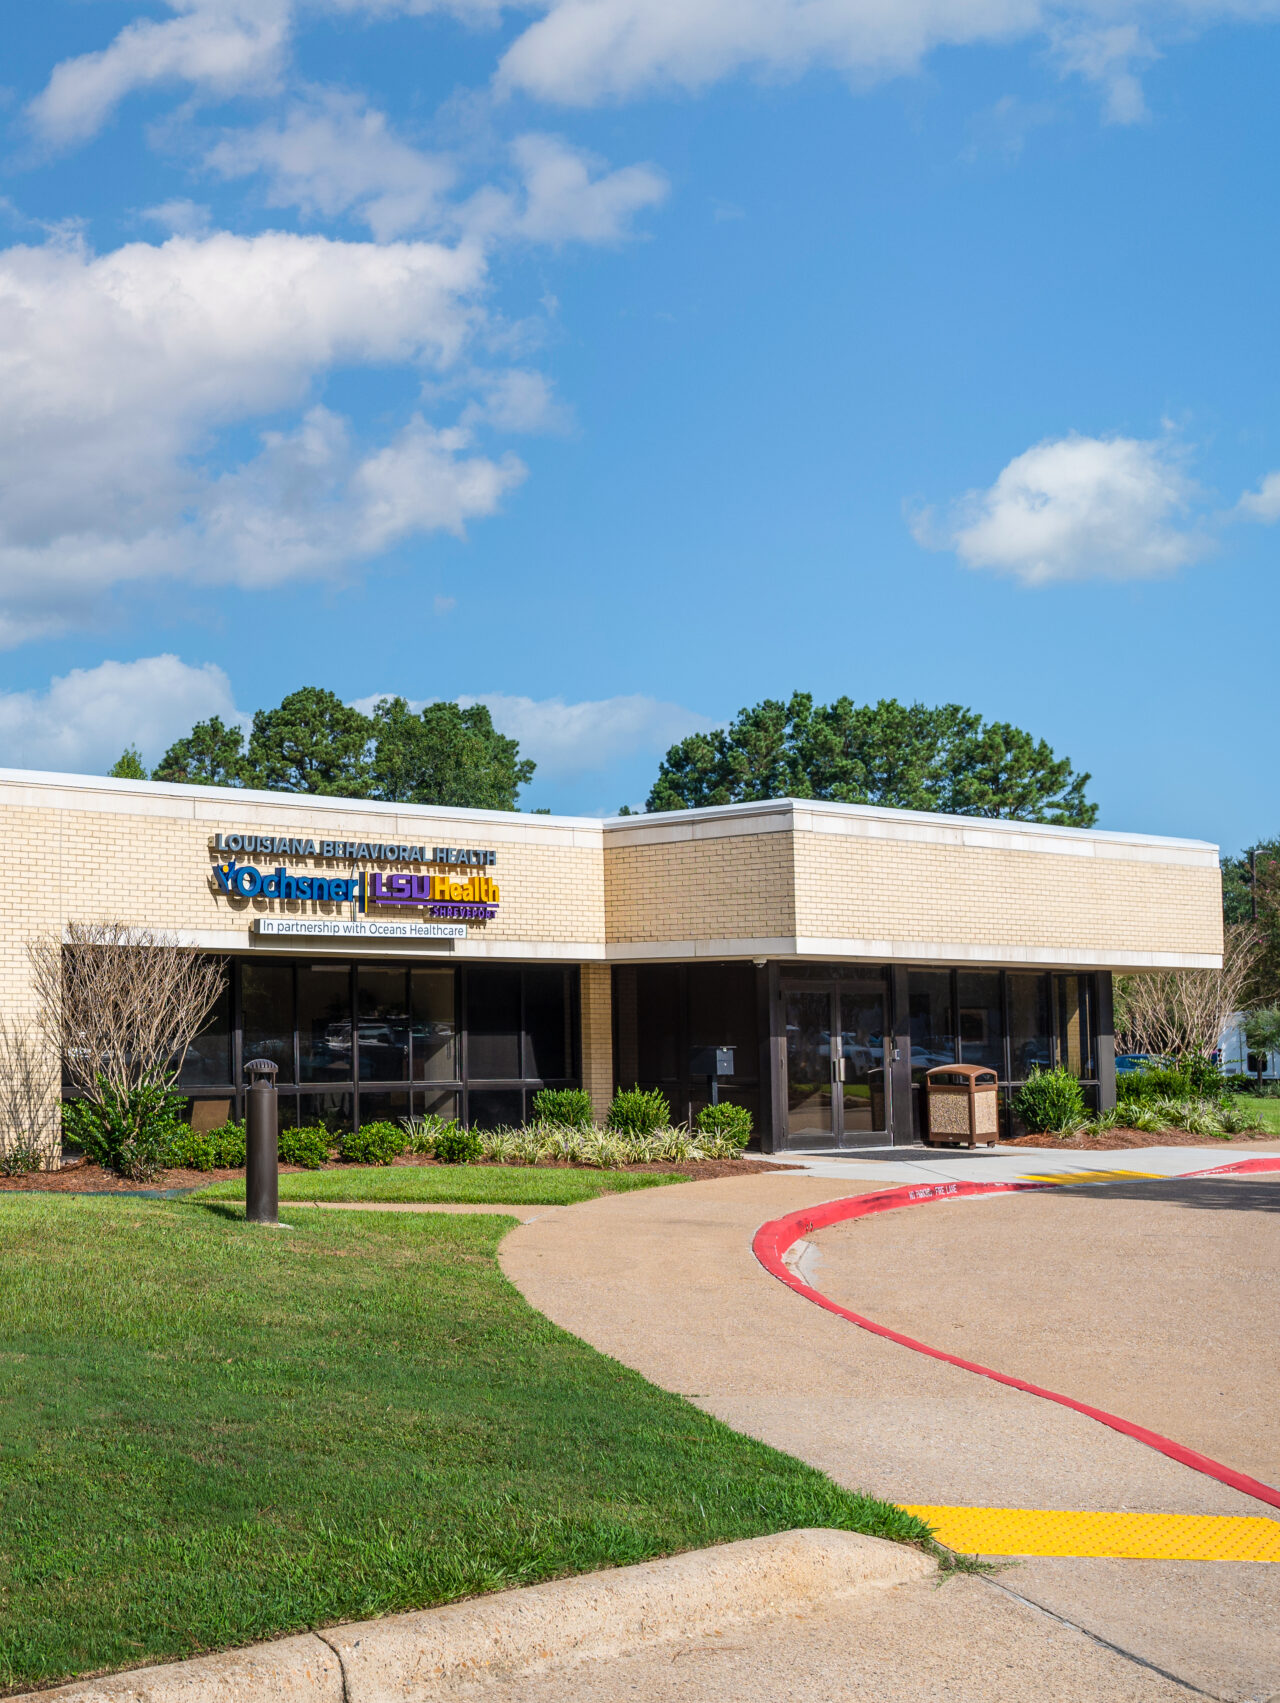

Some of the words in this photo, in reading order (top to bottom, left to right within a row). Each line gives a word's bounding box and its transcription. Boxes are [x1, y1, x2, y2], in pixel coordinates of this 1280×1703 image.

[215, 833, 317, 855] LOUISIANA
[320, 840, 431, 862] BEHAVIORAL
[433, 847, 496, 865] HEALTH
[233, 866, 359, 902] Ochsner
[371, 873, 430, 899] LSU
[431, 876, 499, 902] Health
[431, 906, 497, 919] SHREVEPORT
[263, 920, 274, 932] In
[277, 921, 340, 935] partnership
[342, 923, 366, 935] with
[369, 924, 407, 935] Oceans
[410, 926, 464, 936] Healthcare
[934, 1186, 945, 1196] FIRE
[945, 1184, 958, 1194] LANE
